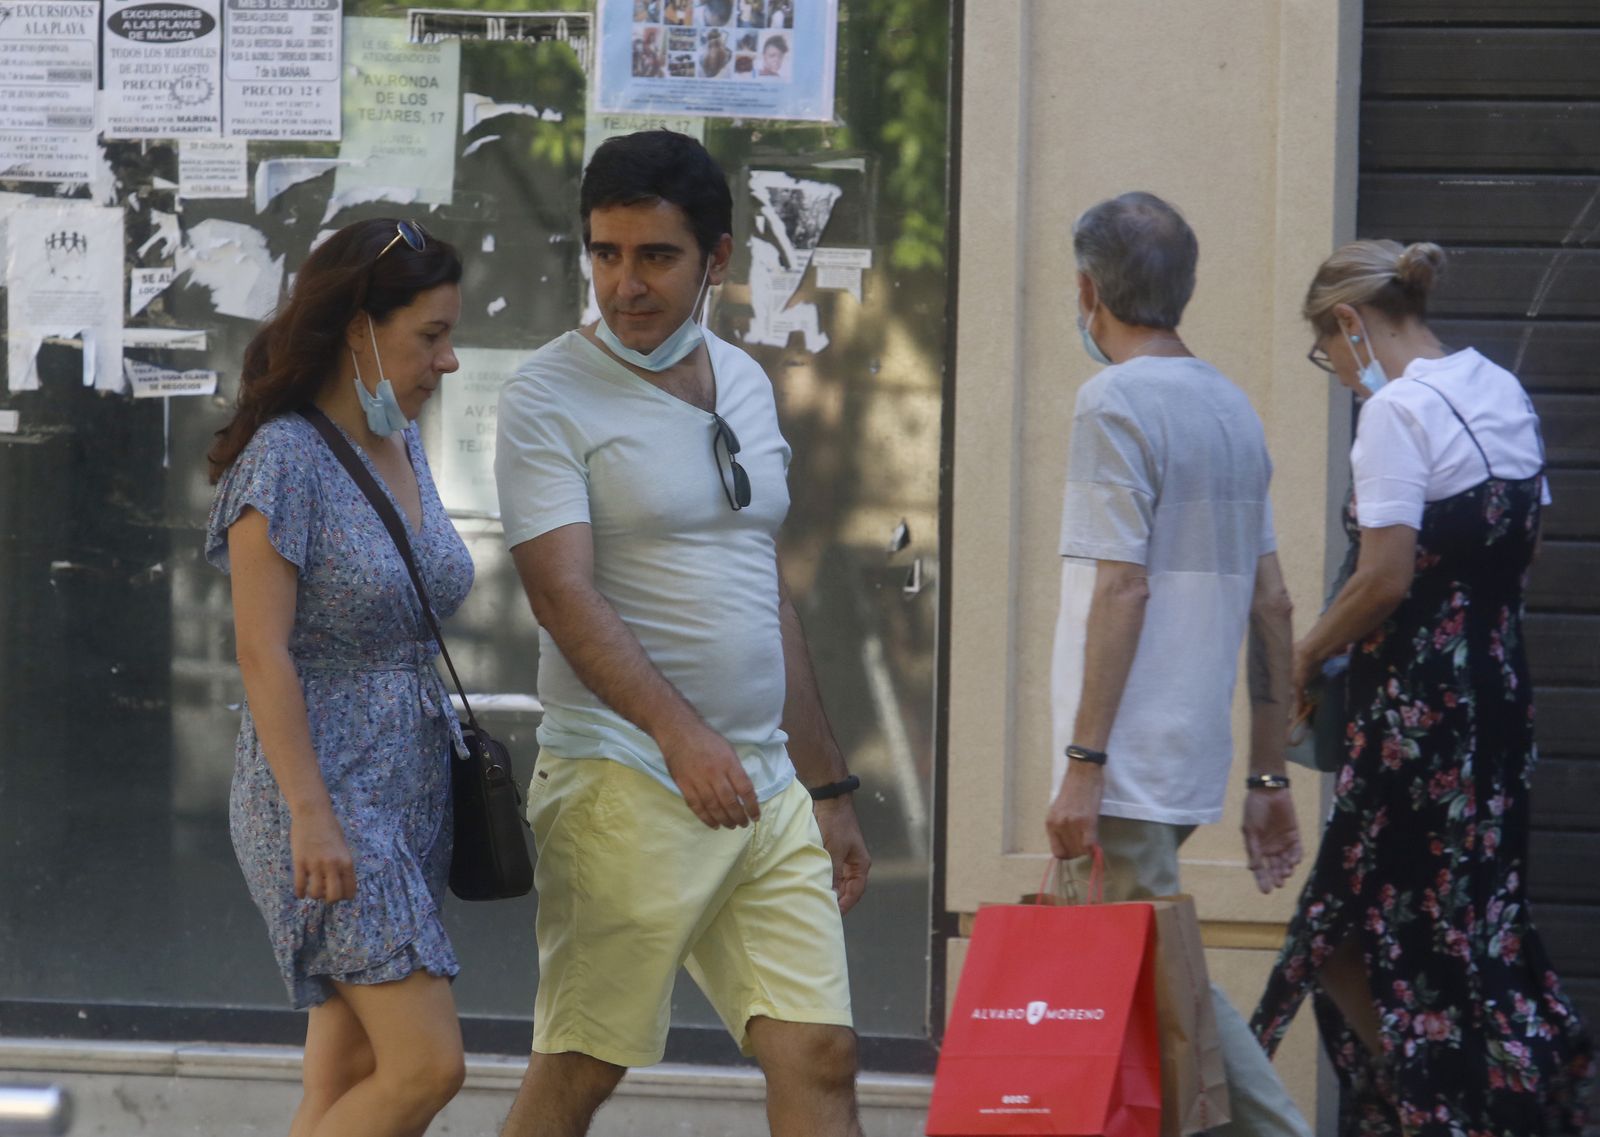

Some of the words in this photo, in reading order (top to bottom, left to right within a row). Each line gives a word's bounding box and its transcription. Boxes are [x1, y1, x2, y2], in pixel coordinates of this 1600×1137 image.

[237, 0, 266, 9] MES
[269, 0, 288, 9] DE
[291, 0, 330, 9] JULIO
[15, 5, 95, 18] EXCURSIONES
[121, 9, 203, 19] EXCURSIONES
[24, 22, 32, 35] A
[33, 22, 49, 35] LA
[50, 22, 87, 35] PLAYA
[122, 20, 132, 29] A
[133, 20, 156, 29] LAS
[158, 20, 202, 29] PLAYAS
[128, 31, 145, 40] DE
[111, 47, 141, 59] TODOS
[143, 47, 162, 59] LOS
[119, 64, 132, 75] DE
[135, 64, 161, 75] JULIO
[172, 64, 210, 75] AGOSTO
[122, 80, 171, 91] PRECIO
[241, 85, 293, 97] PRECIO
[301, 85, 313, 97] 12
[315, 86, 325, 97] €
[375, 91, 396, 105] DE
[399, 93, 429, 106] LOS
[176, 115, 218, 123] MARINA
[358, 108, 425, 124] TEJARES,
[429, 112, 446, 124] 17
[112, 126, 160, 134] SEGURIDAD
[162, 126, 168, 134] Y
[232, 129, 279, 137] SEGURIDAD
[282, 129, 288, 137] Y
[141, 274, 155, 284] SE
[971, 1008, 1026, 1020] ALVARO
[1045, 1008, 1105, 1021] MORENO
